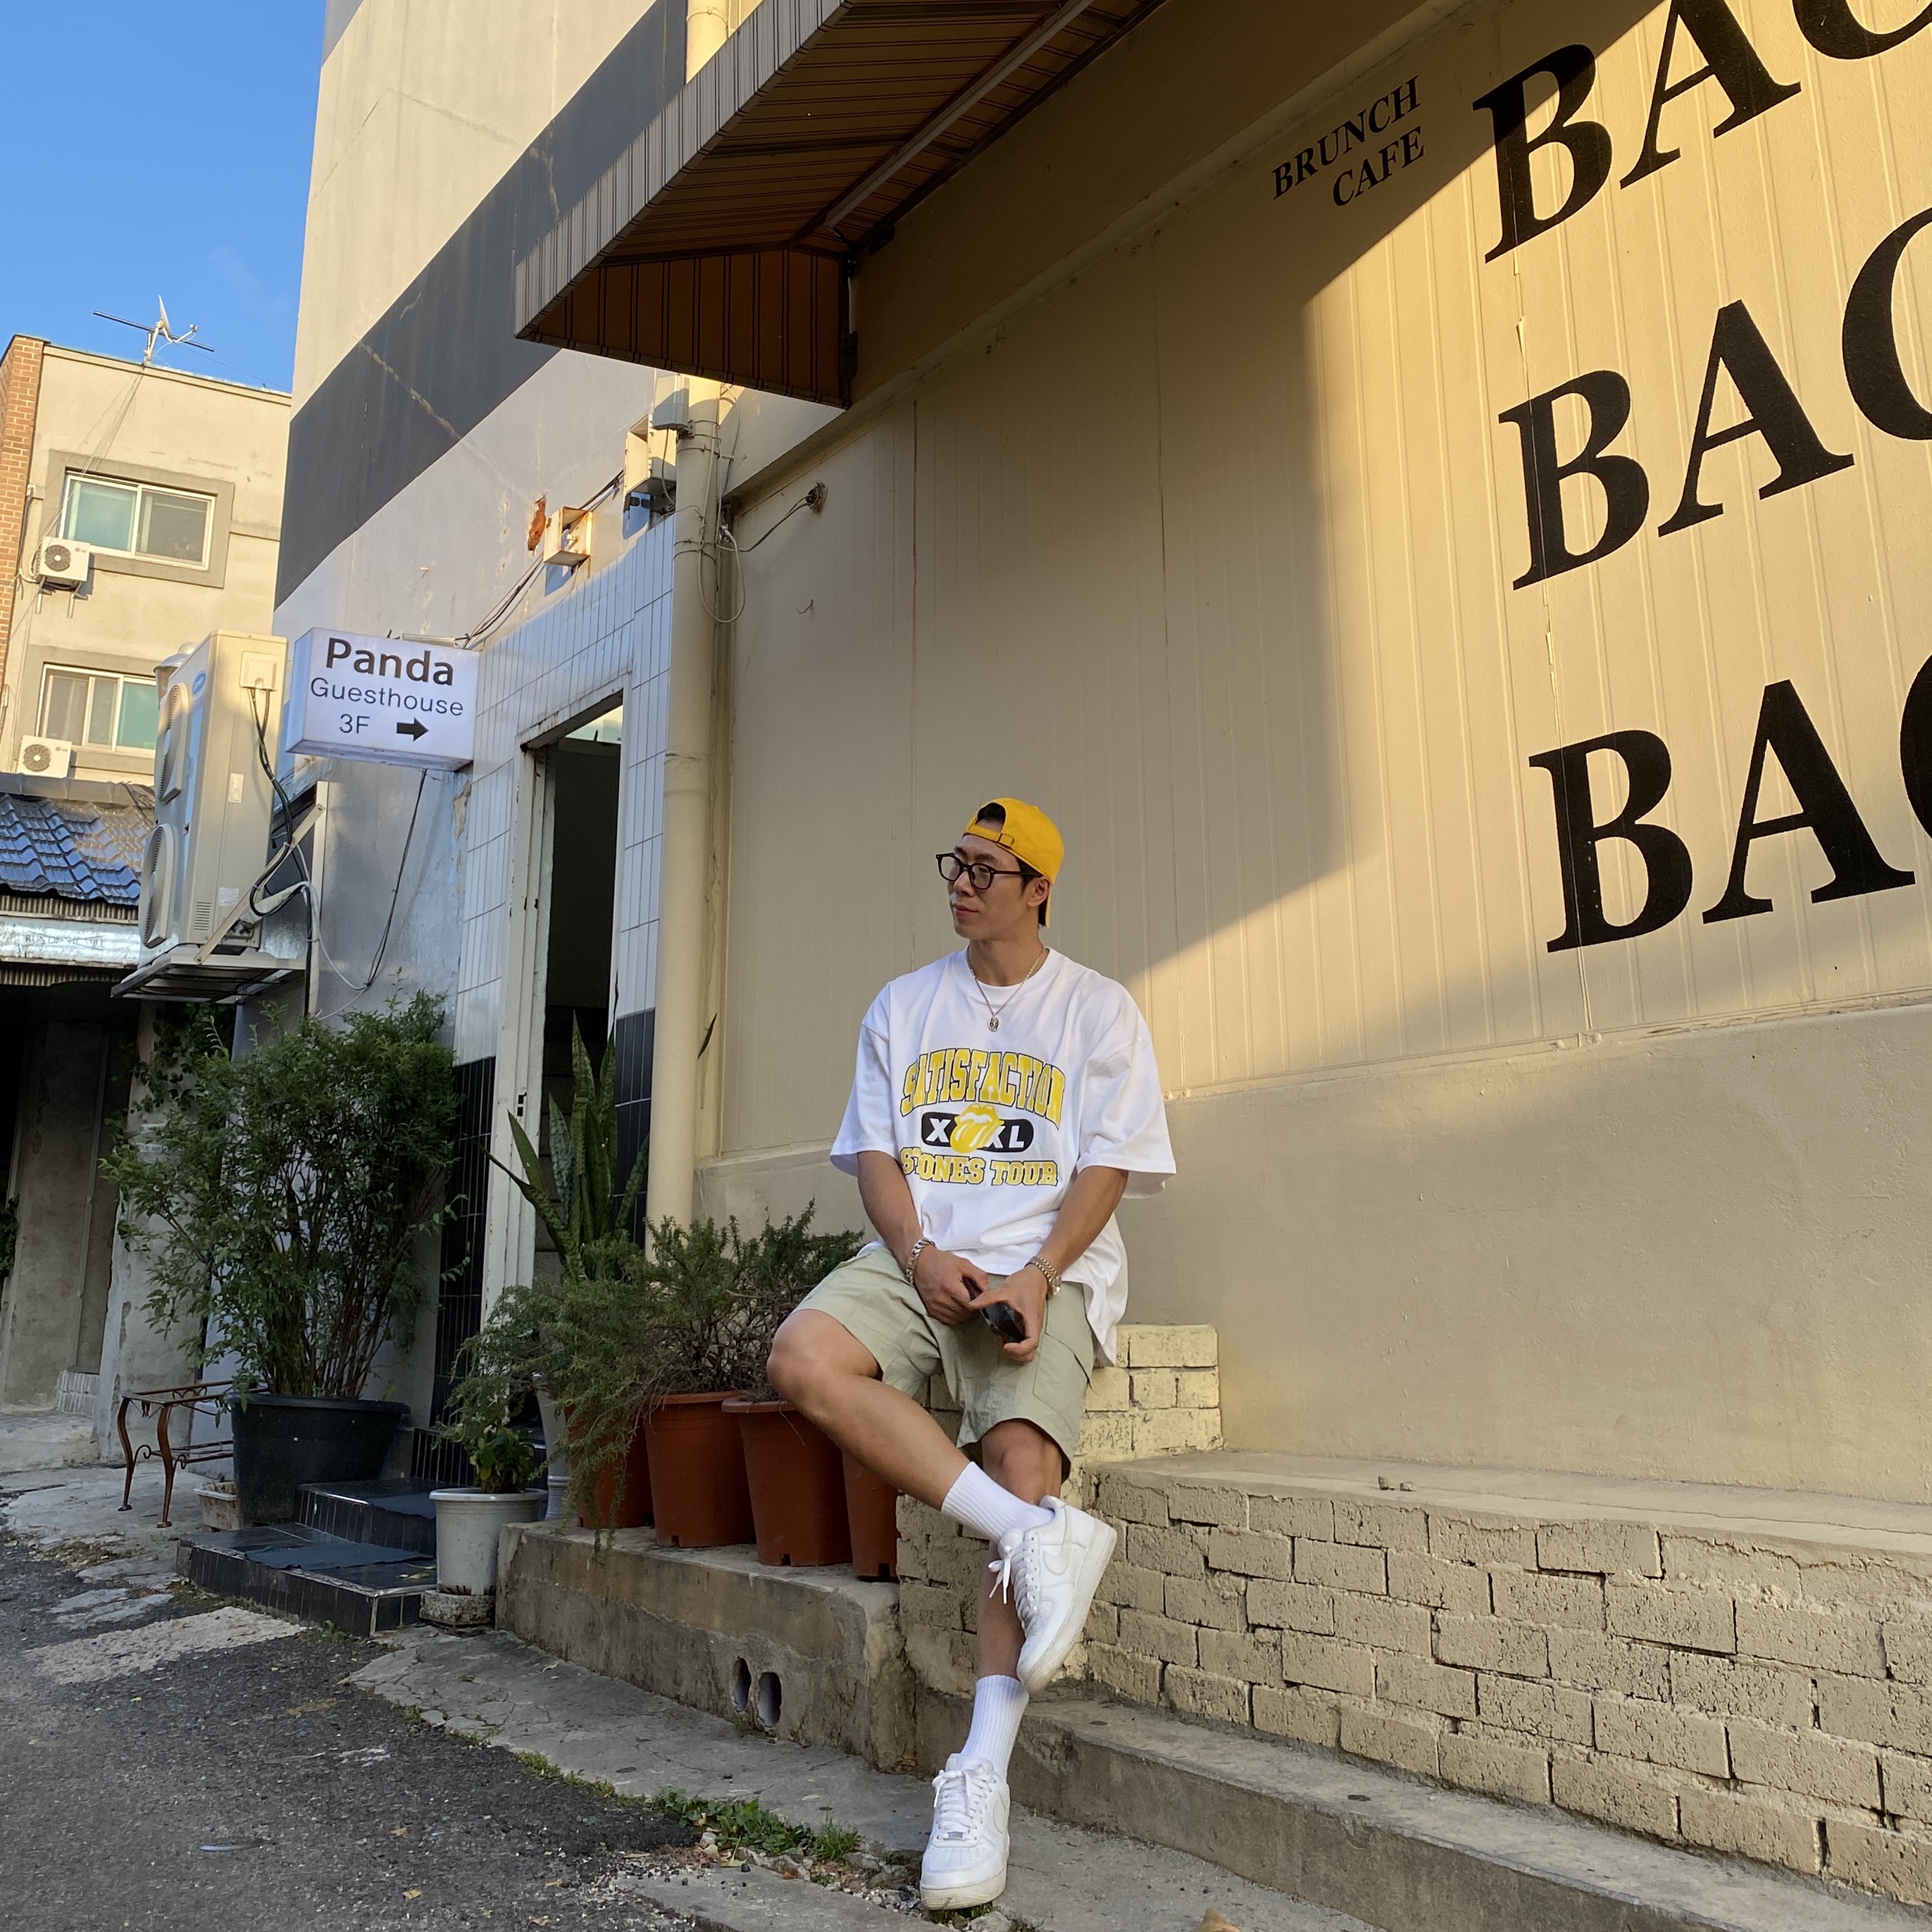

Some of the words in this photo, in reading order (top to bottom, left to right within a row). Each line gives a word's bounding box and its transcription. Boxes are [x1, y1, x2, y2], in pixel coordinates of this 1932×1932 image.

[1272, 75, 1421, 200] BRUNCH
[1333, 125, 1424, 206] CAFE
[326, 637, 454, 686] Panda
[311, 677, 463, 716] Guesthouse
[339, 713, 370, 734] 3F
[899, 1147, 986, 1185] STONES
[990, 1159, 1059, 1187] TOUR
